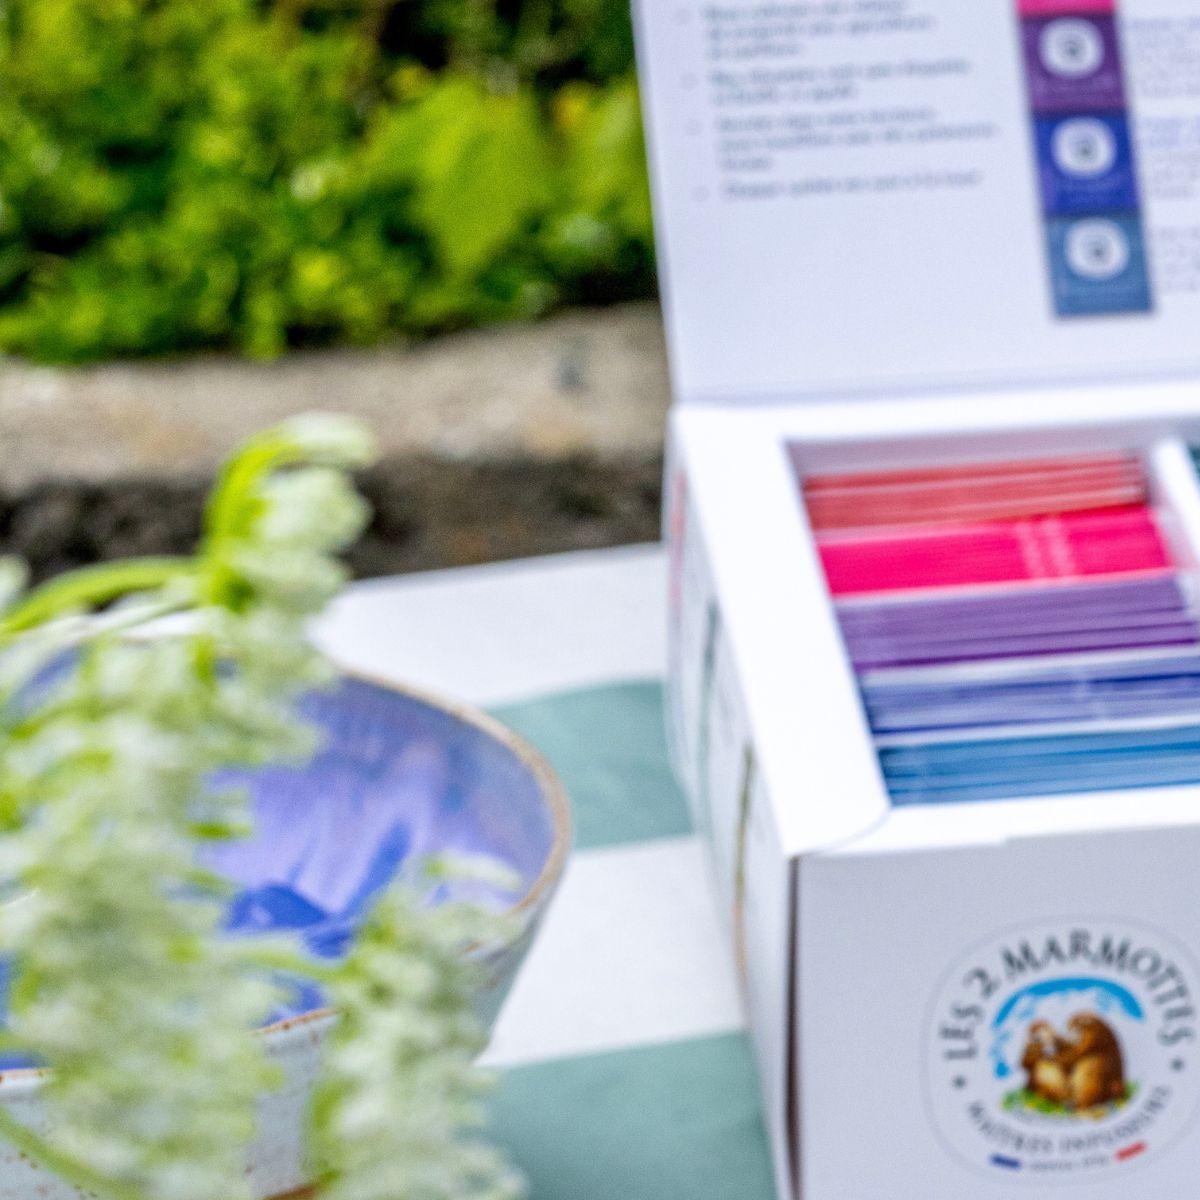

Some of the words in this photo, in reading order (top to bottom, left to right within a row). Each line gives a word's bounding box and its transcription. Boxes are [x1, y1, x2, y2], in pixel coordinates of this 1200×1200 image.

[939, 1003, 983, 1060] LES
[963, 967, 1001, 1000] 2
[1002, 929, 1195, 1047] MARMOTTES
